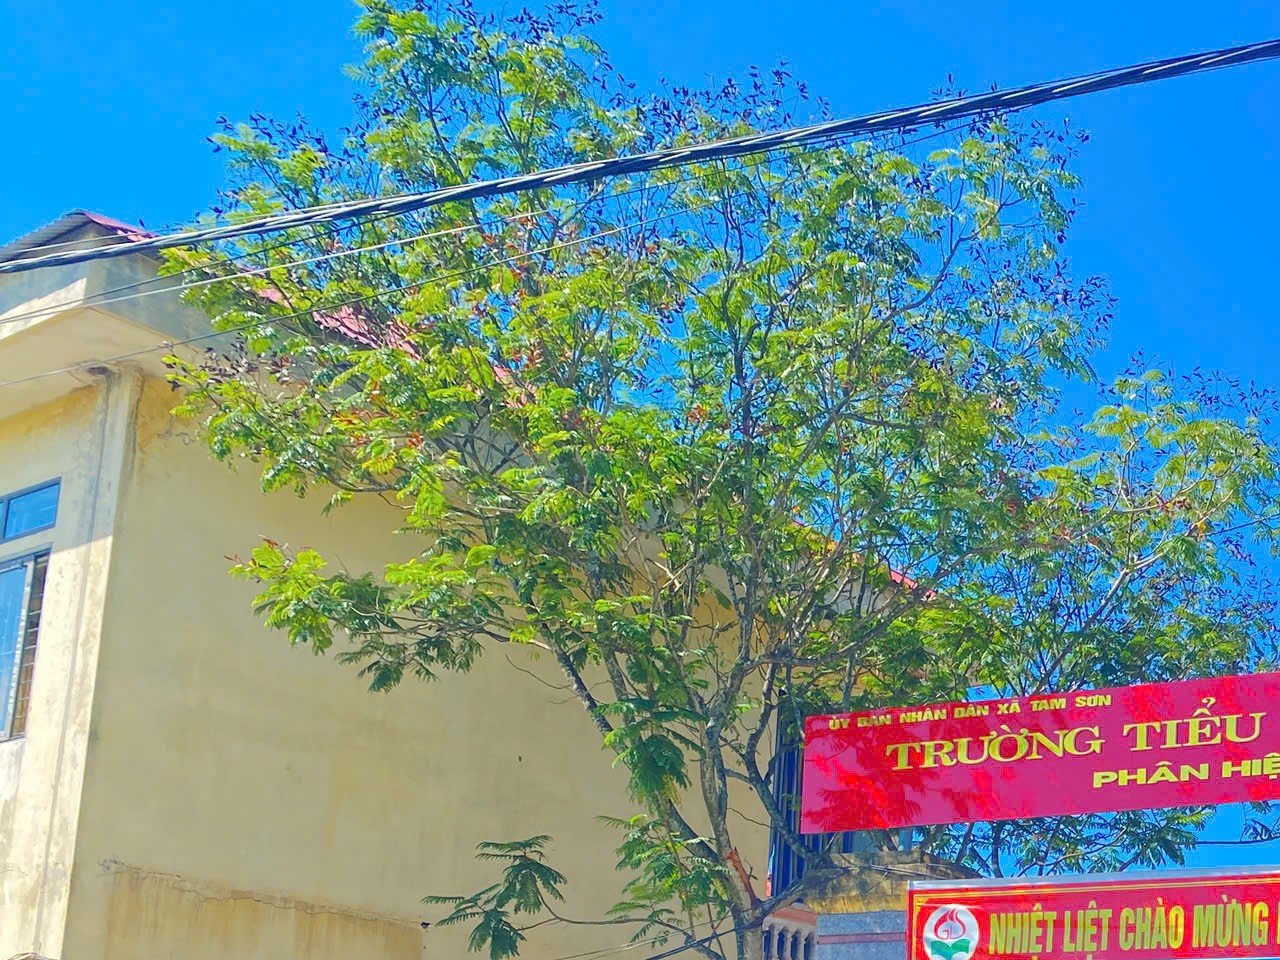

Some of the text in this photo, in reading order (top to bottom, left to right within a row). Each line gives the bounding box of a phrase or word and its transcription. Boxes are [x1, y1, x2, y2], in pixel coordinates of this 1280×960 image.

[857, 714, 891, 727] BAN
[900, 708, 946, 723] NHÂN
[954, 704, 989, 718] DÂN
[997, 699, 1020, 714] XÃ
[1032, 698, 1066, 711] TAM
[1076, 694, 1112, 708] SƠN
[886, 725, 1105, 770] TRƯỜNG
[1123, 697, 1267, 751] TIỂU
[1093, 760, 1209, 788] PHÂN
[1063, 901, 1113, 960] LIỆT
[1119, 897, 1184, 949] CHÀO
[1193, 894, 1269, 947] MỪNG
